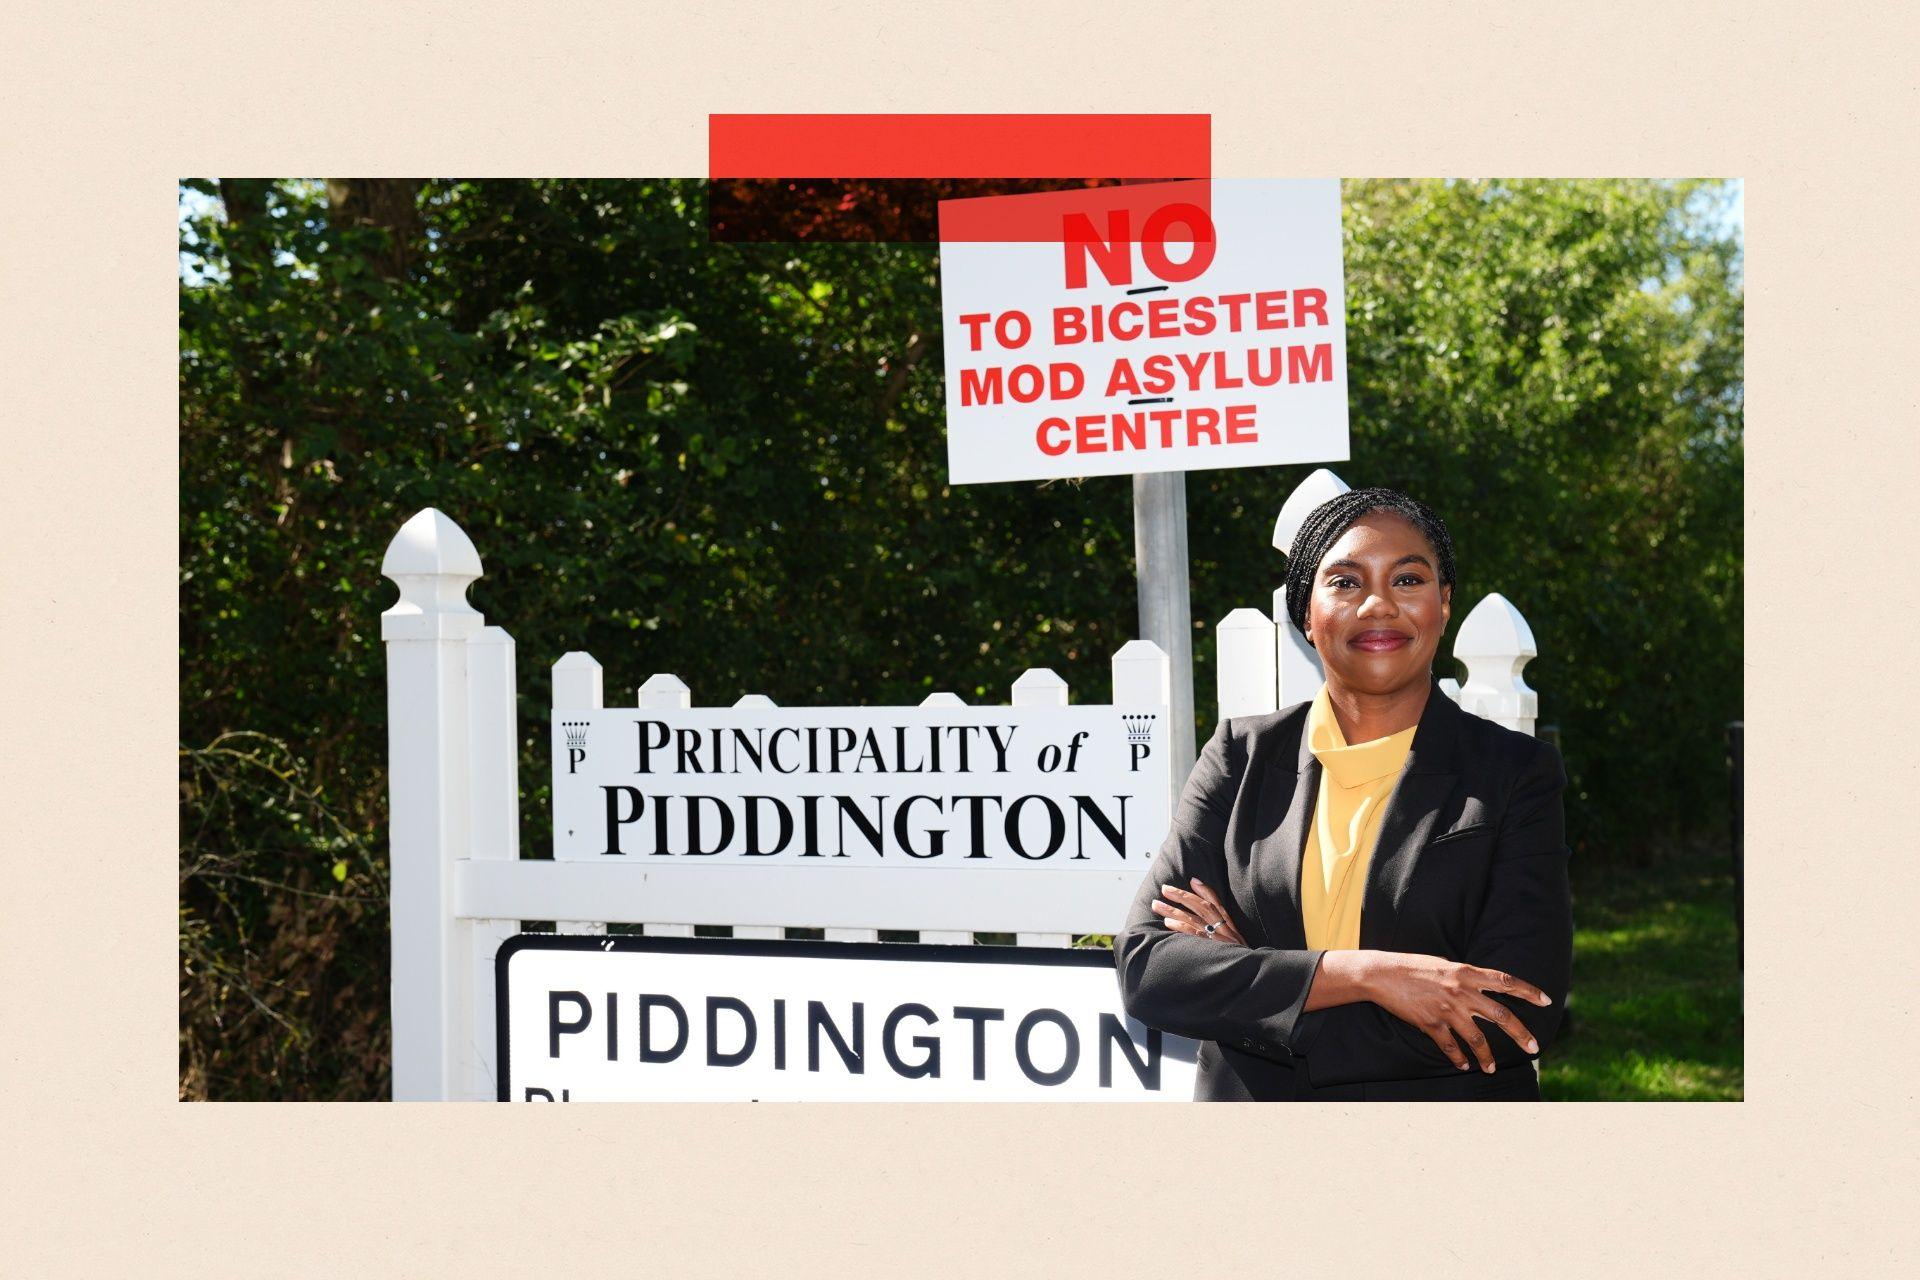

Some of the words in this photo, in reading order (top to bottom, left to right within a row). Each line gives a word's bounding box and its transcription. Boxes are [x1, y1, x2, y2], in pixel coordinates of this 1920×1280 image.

[1062, 202, 1217, 290] NO
[959, 310, 1032, 352] TO
[1052, 287, 1330, 346] BICESTER
[959, 362, 1086, 407] MOD
[1104, 343, 1334, 397] ASYLUM
[1035, 404, 1259, 457] CENTRE
[633, 720, 1019, 774] PRINCIPALITY
[1036, 731, 1090, 773] of
[599, 785, 1134, 860] PIDDINGTON
[547, 990, 1163, 1092] PIDDINGTON
